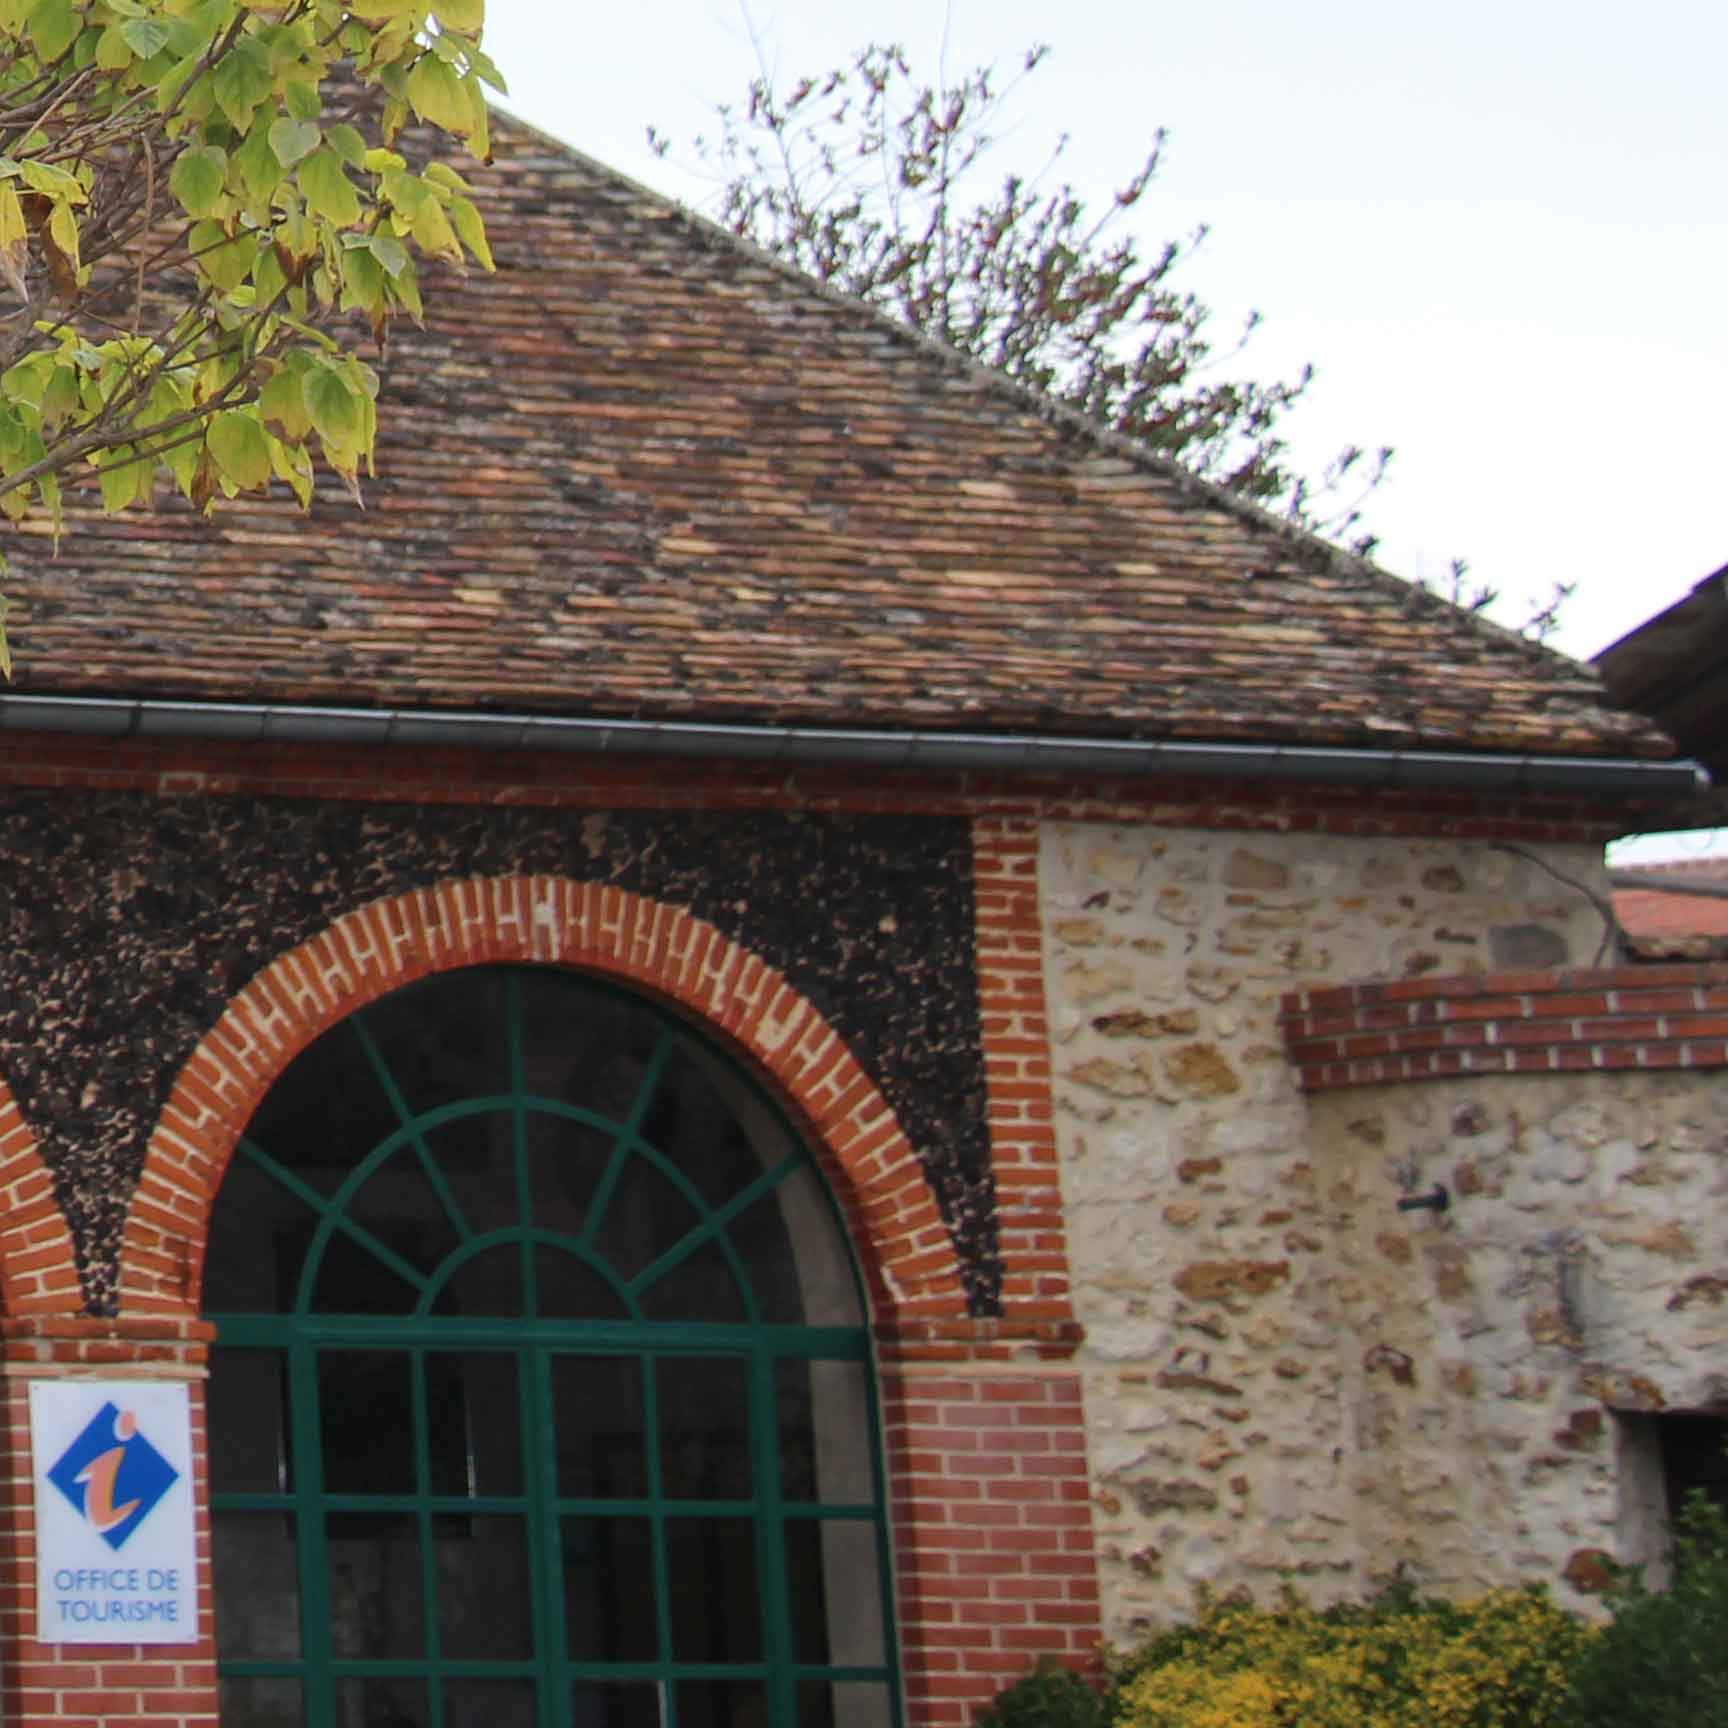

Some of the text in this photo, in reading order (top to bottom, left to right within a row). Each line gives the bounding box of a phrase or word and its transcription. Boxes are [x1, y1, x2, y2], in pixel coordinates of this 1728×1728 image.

[54, 1569, 180, 1591] OFFICE DE
[56, 1599, 179, 1623] TOURISME
